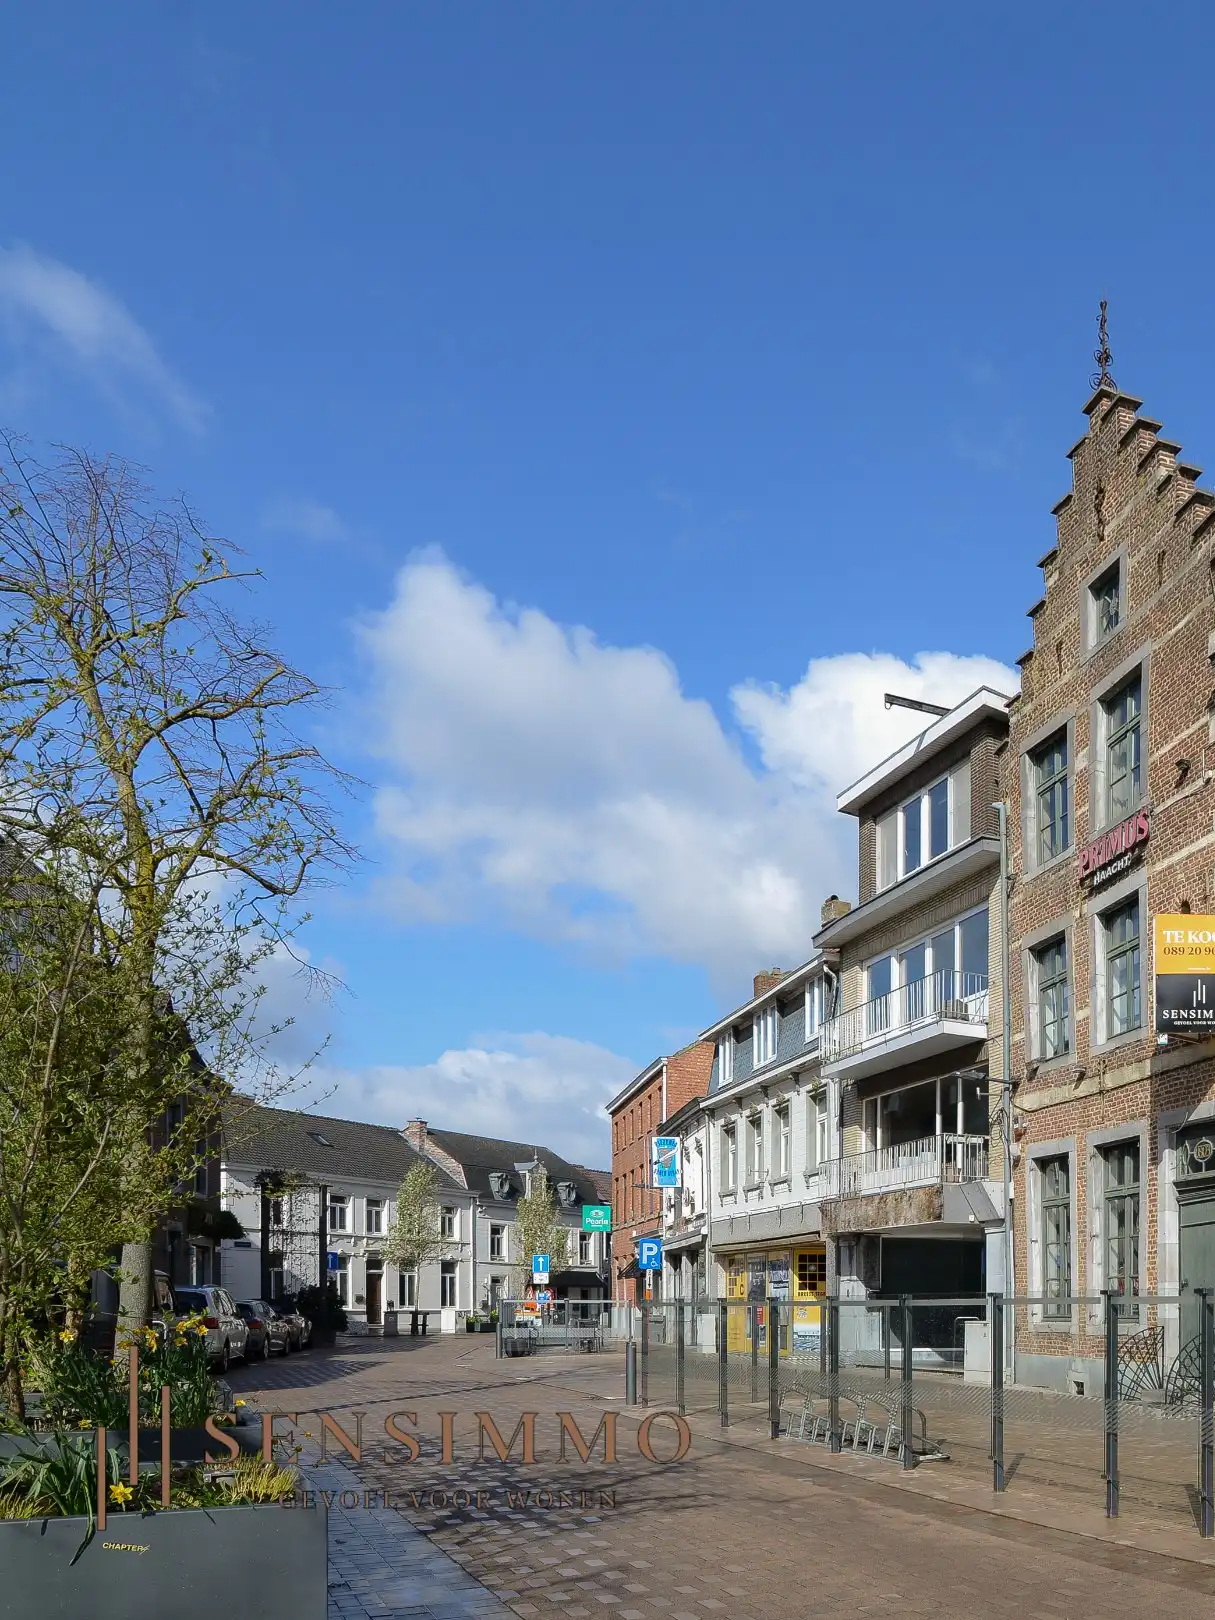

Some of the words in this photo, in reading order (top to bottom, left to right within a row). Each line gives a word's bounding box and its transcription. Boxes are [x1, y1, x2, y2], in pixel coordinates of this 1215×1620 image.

[1079, 805, 1149, 880] PRIMUS
[1094, 853, 1131, 887] HAACHT
[1163, 930, 1184, 944] TE
[1163, 946, 1185, 956] 089
[1187, 946, 1202, 956] 20
[642, 1243, 658, 1264] P
